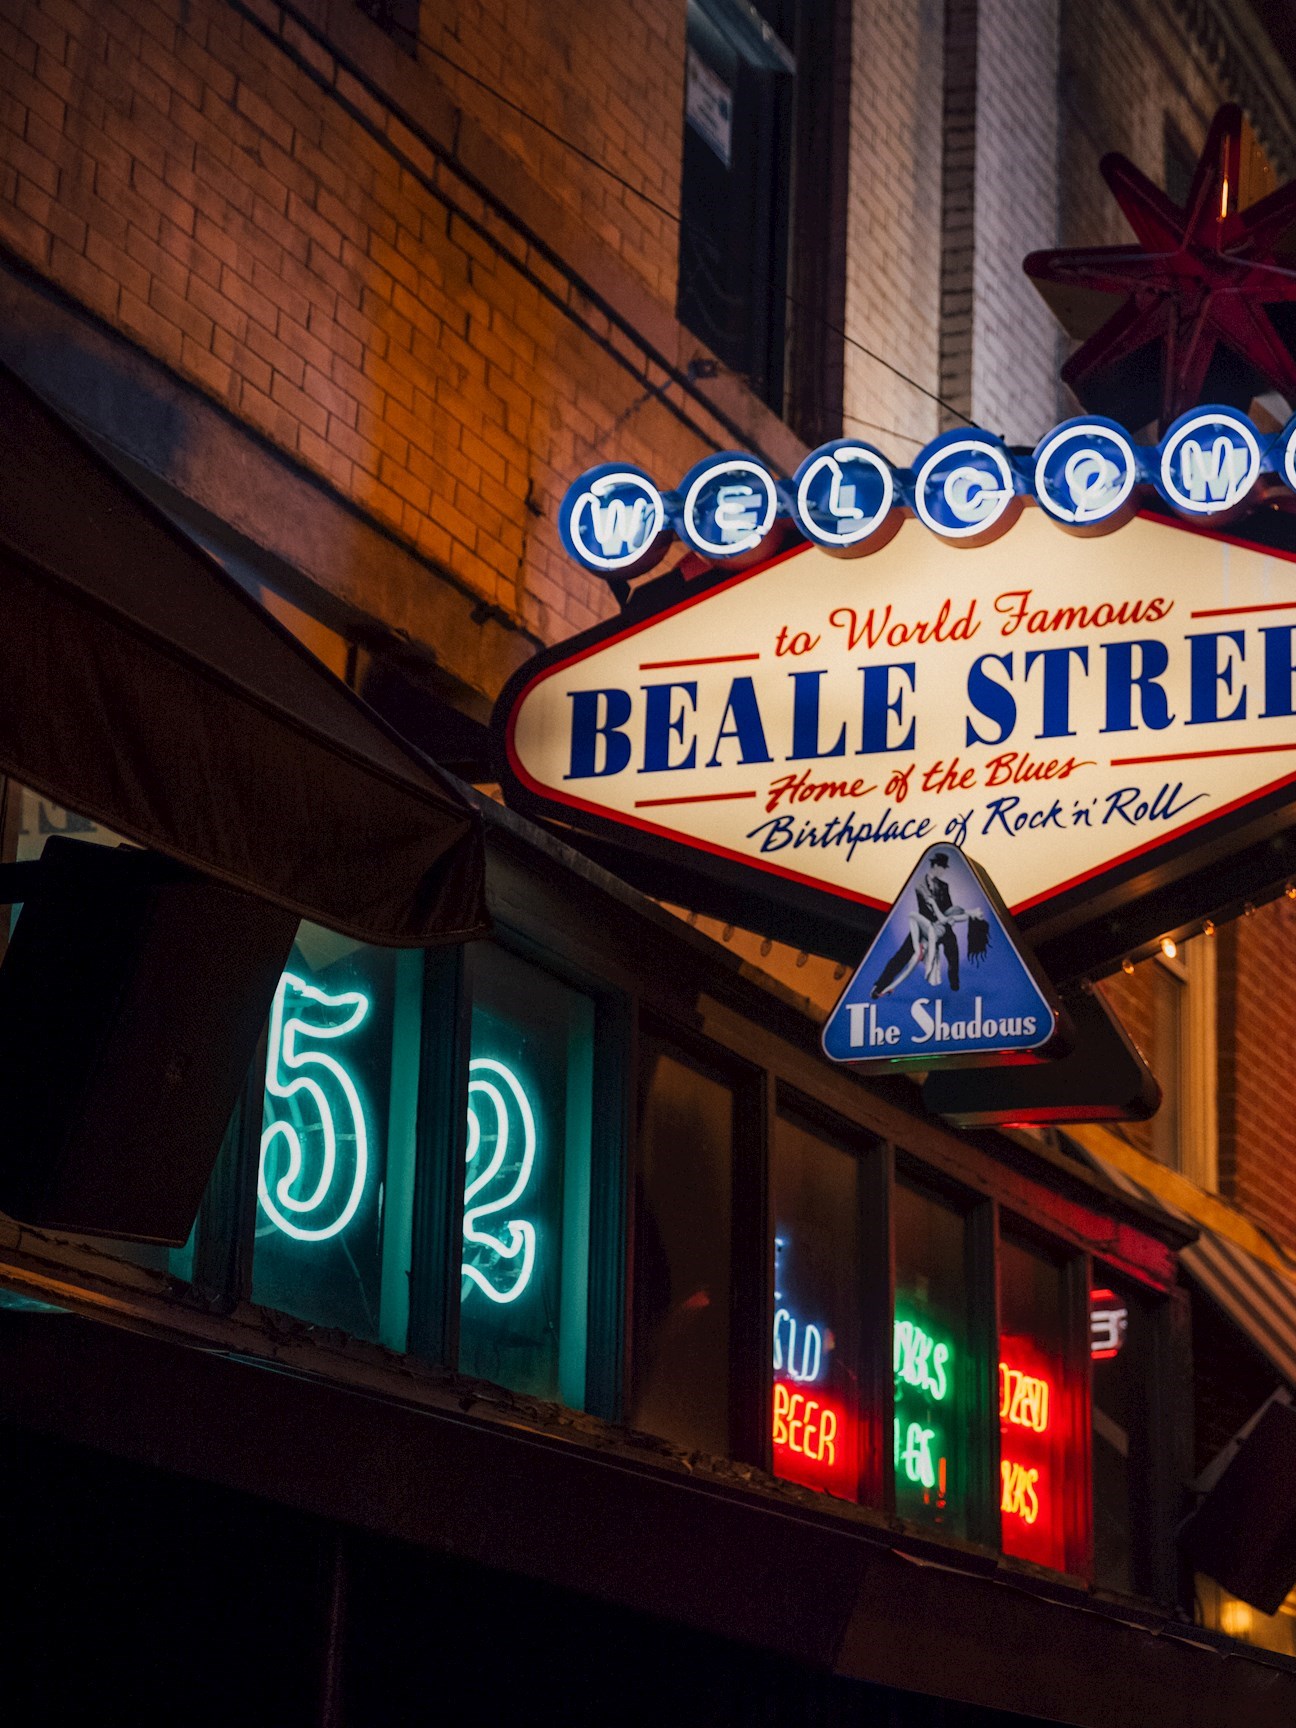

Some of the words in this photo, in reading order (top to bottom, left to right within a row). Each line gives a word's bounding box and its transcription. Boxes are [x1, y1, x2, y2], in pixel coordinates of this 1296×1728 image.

[774, 625, 821, 658] to
[829, 598, 981, 652] World
[993, 588, 1175, 638] Famous
[562, 661, 918, 781] BEALE
[765, 768, 877, 814] Home
[884, 763, 917, 804] of
[921, 755, 979, 794] the
[984, 751, 1099, 788] Blues
[745, 811, 937, 863] Birthplace
[944, 808, 975, 847] of
[845, 1002, 901, 1049] The
[909, 995, 1038, 1044] Shadows
[773, 1383, 837, 1467] BEER
